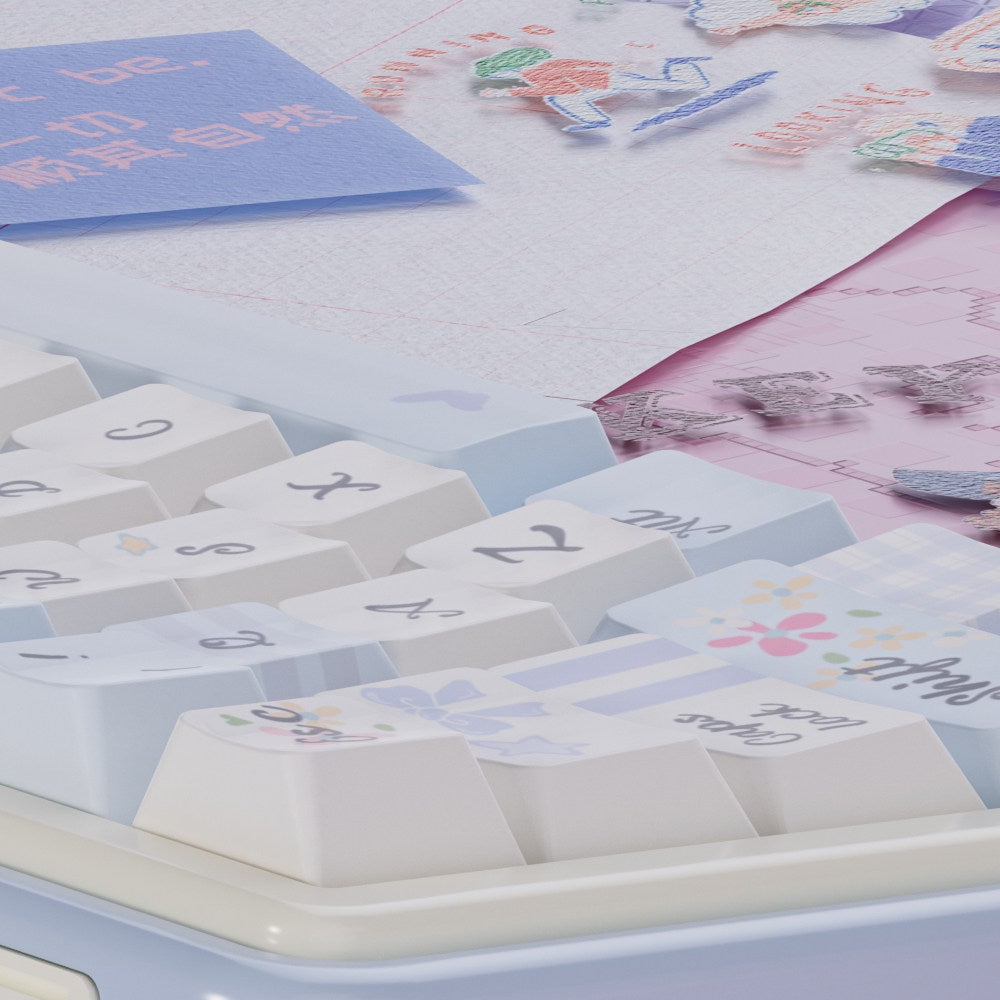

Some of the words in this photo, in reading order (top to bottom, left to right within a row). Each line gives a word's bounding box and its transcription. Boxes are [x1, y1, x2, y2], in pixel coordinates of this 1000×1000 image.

[57, 55, 212, 86] be.
[105, 418, 173, 441] C
[287, 472, 381, 501] X
[611, 509, 731, 540] Alt
[175, 542, 255, 557] S
[473, 525, 583, 564] Z
[364, 598, 464, 620] A
[199, 630, 275, 651] Q
[840, 657, 1000, 707] Shift
[673, 713, 802, 747] Caps
